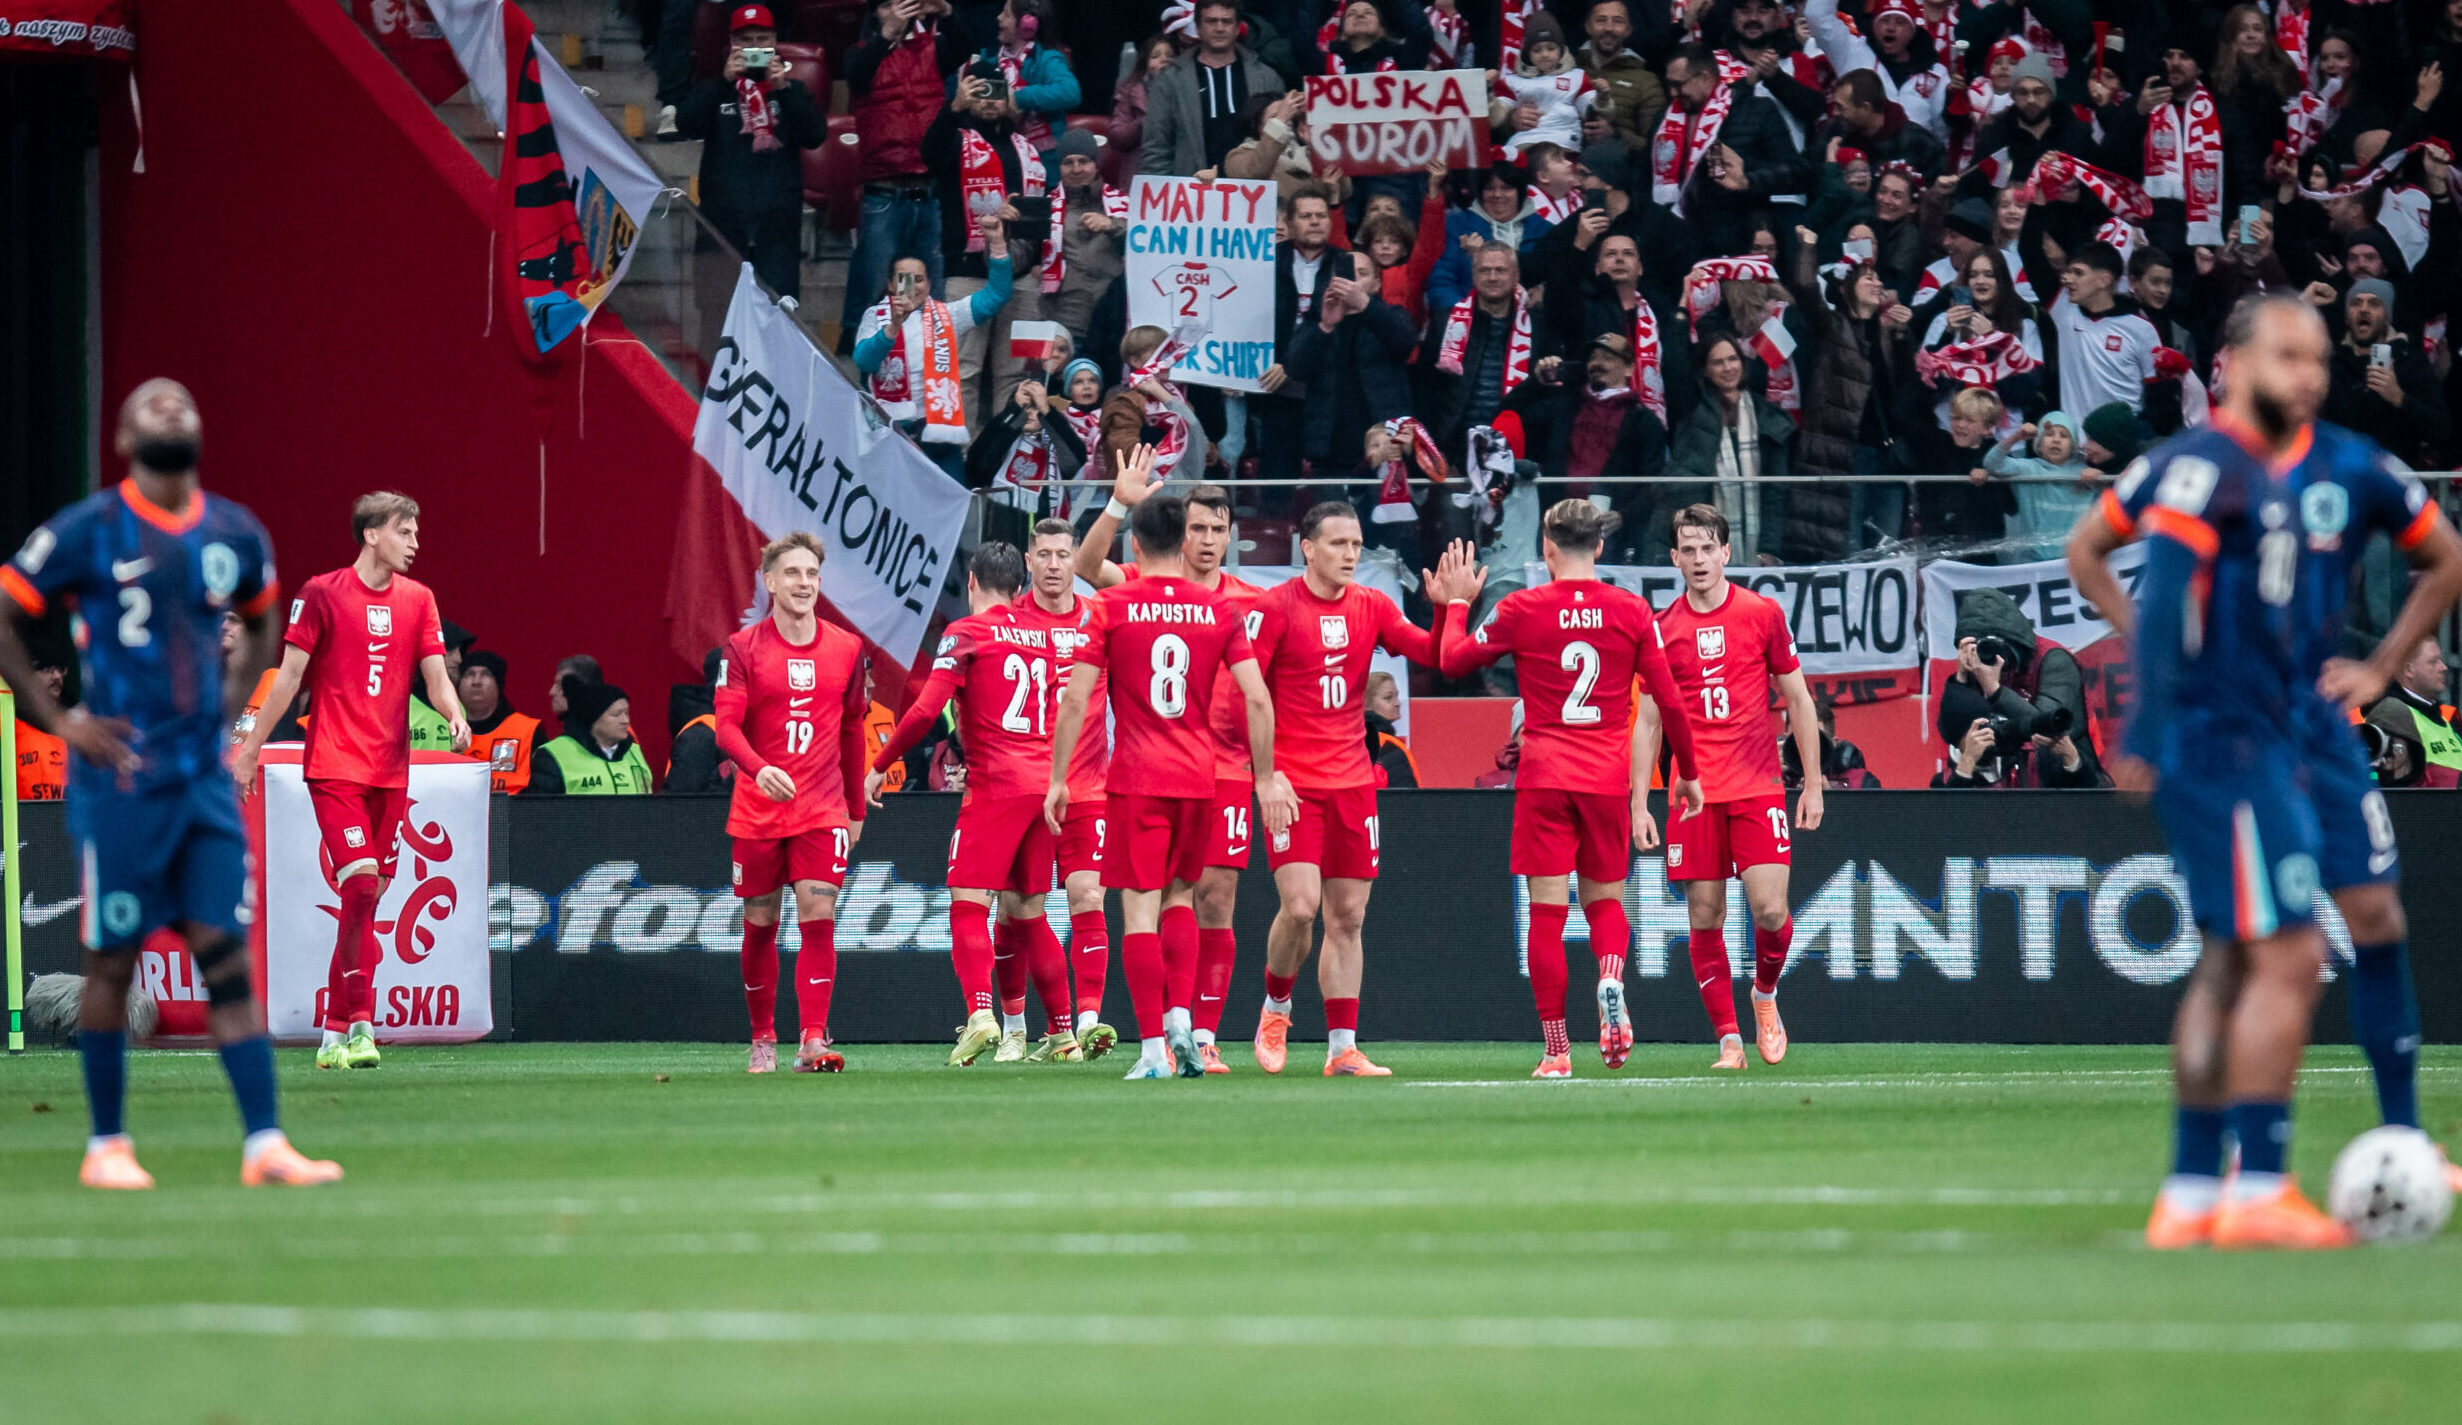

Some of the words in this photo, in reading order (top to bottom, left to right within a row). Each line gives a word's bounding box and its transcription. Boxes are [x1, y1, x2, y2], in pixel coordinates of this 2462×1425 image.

[14, 20, 87, 46] naszym
[1304, 75, 1470, 117] POLSKA
[1309, 118, 1478, 170] GUROM
[1140, 181, 1266, 224] MATTY
[1129, 224, 1188, 255] CAN
[1195, 226, 1204, 257] I
[1211, 227, 1276, 262] HAVE
[1175, 272, 1210, 286] CASH
[1179, 285, 1199, 317] 2
[1205, 340, 1275, 380] SHIRT
[117, 585, 153, 648] 2
[1127, 602, 1217, 626] KAPUSTKA
[1558, 607, 1604, 630] CASH
[990, 625, 1047, 649] ZALEWSKI
[366, 663, 384, 698] 5
[1001, 652, 1048, 736] 21
[1150, 632, 1190, 720] 8
[1318, 674, 1348, 710] 10
[1560, 640, 1602, 725] 2
[1699, 685, 1730, 721] 13
[785, 719, 814, 755] 19
[581, 775, 602, 789] 444
[1095, 818, 1107, 848] 9
[1223, 806, 1248, 841] 14
[1767, 806, 1789, 841] 13
[1516, 854, 2357, 984] PHANTO
